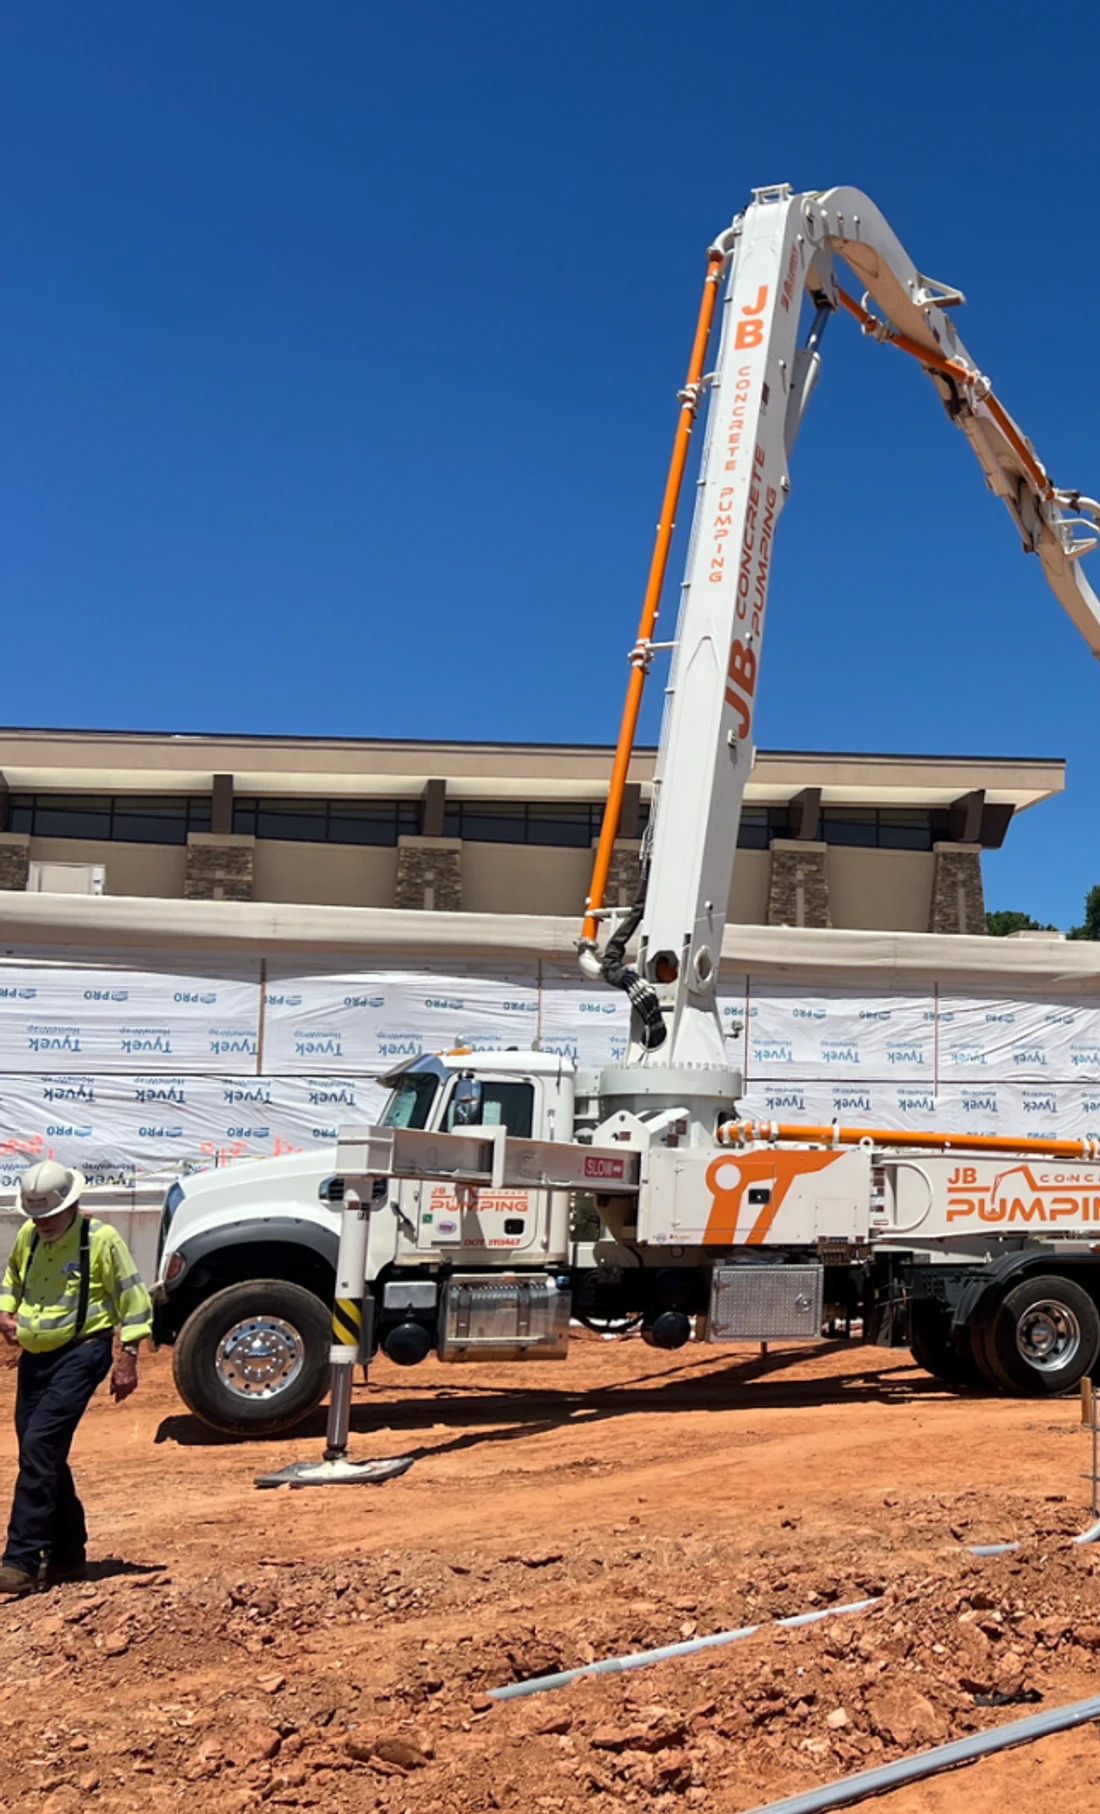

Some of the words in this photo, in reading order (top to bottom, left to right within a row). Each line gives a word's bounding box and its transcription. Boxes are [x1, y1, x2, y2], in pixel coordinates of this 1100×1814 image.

[734, 285, 768, 351] JB
[724, 366, 752, 471] CONCRETE
[708, 487, 735, 583] PUMPING
[736, 445, 765, 620] CONCRETE
[751, 483, 777, 636] PUMPING
[723, 638, 758, 739] JB
[29, 1036, 82, 1053] Tyvek
[121, 1037, 173, 1054] Tyvek
[210, 1039, 257, 1056] Tyvek
[296, 1040, 343, 1056] Tyvek
[754, 1047, 794, 1062] Tyvek
[822, 1049, 860, 1064] Tyvek
[888, 1049, 924, 1064] Tyvek
[44, 1084, 95, 1102] Tyvek
[136, 1086, 186, 1104] Tyvek
[225, 1087, 271, 1104] Tyvek
[310, 1089, 355, 1106] Tyvek
[767, 1096, 806, 1112] Tyvek
[834, 1096, 872, 1112] Tyvek
[899, 1097, 936, 1112] Tyvek
[963, 1098, 998, 1112] Tyvek
[1023, 1101, 1057, 1114] Tyvek
[46, 1126, 74, 1138] PRO
[139, 1126, 165, 1138] PRO
[227, 1127, 252, 1139] PRO
[586, 1159, 612, 1175] SLOW
[947, 1167, 978, 1185] JB
[429, 1200, 529, 1212] PUMPING
[464, 1238, 485, 1247] DOT
